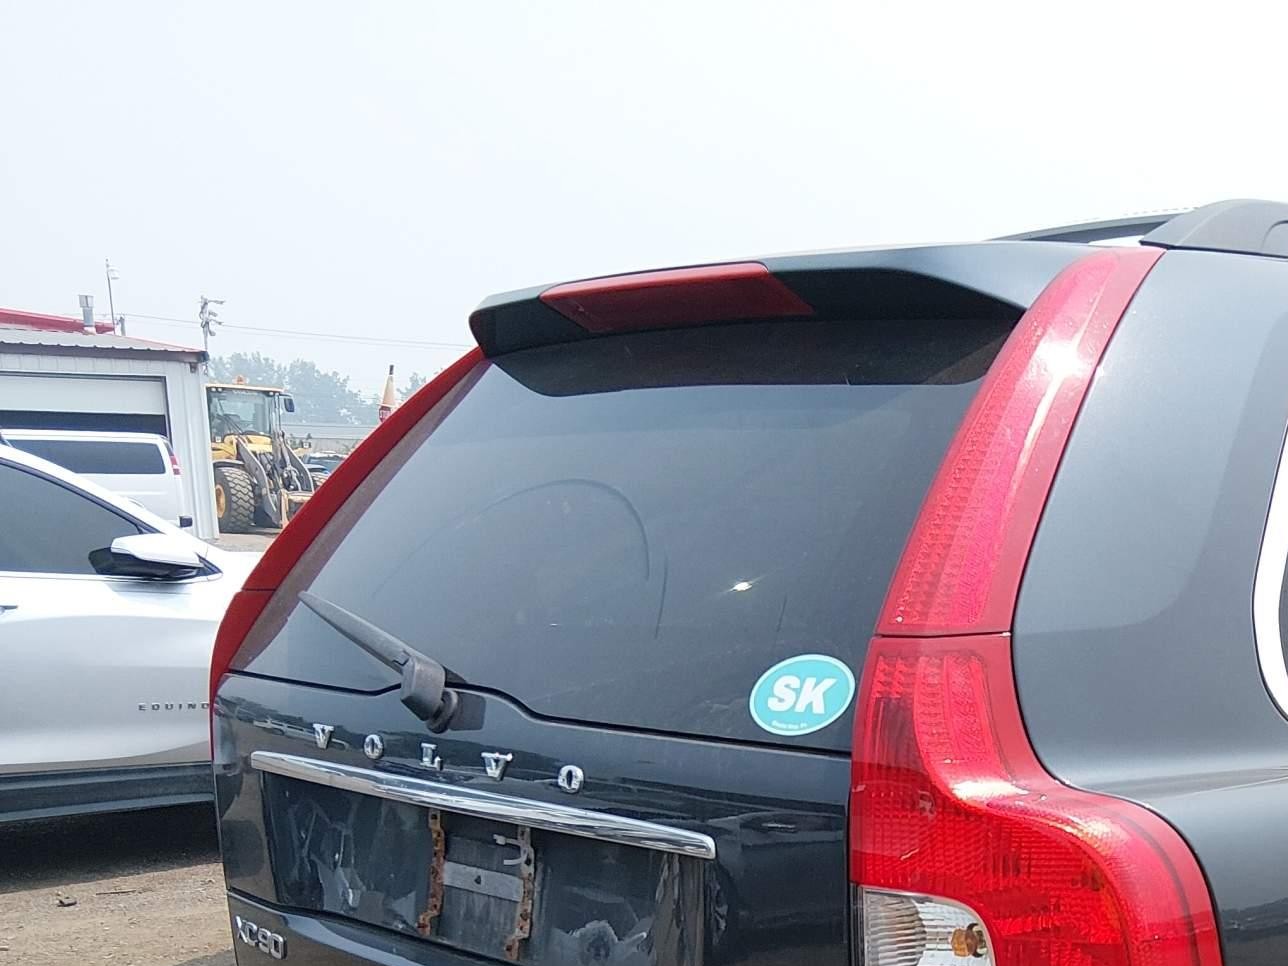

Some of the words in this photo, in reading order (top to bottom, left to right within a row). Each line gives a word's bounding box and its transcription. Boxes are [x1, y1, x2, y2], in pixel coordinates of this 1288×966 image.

[767, 674, 838, 714] SK
[312, 723, 585, 794] VOLVO
[235, 915, 284, 960] XC90
